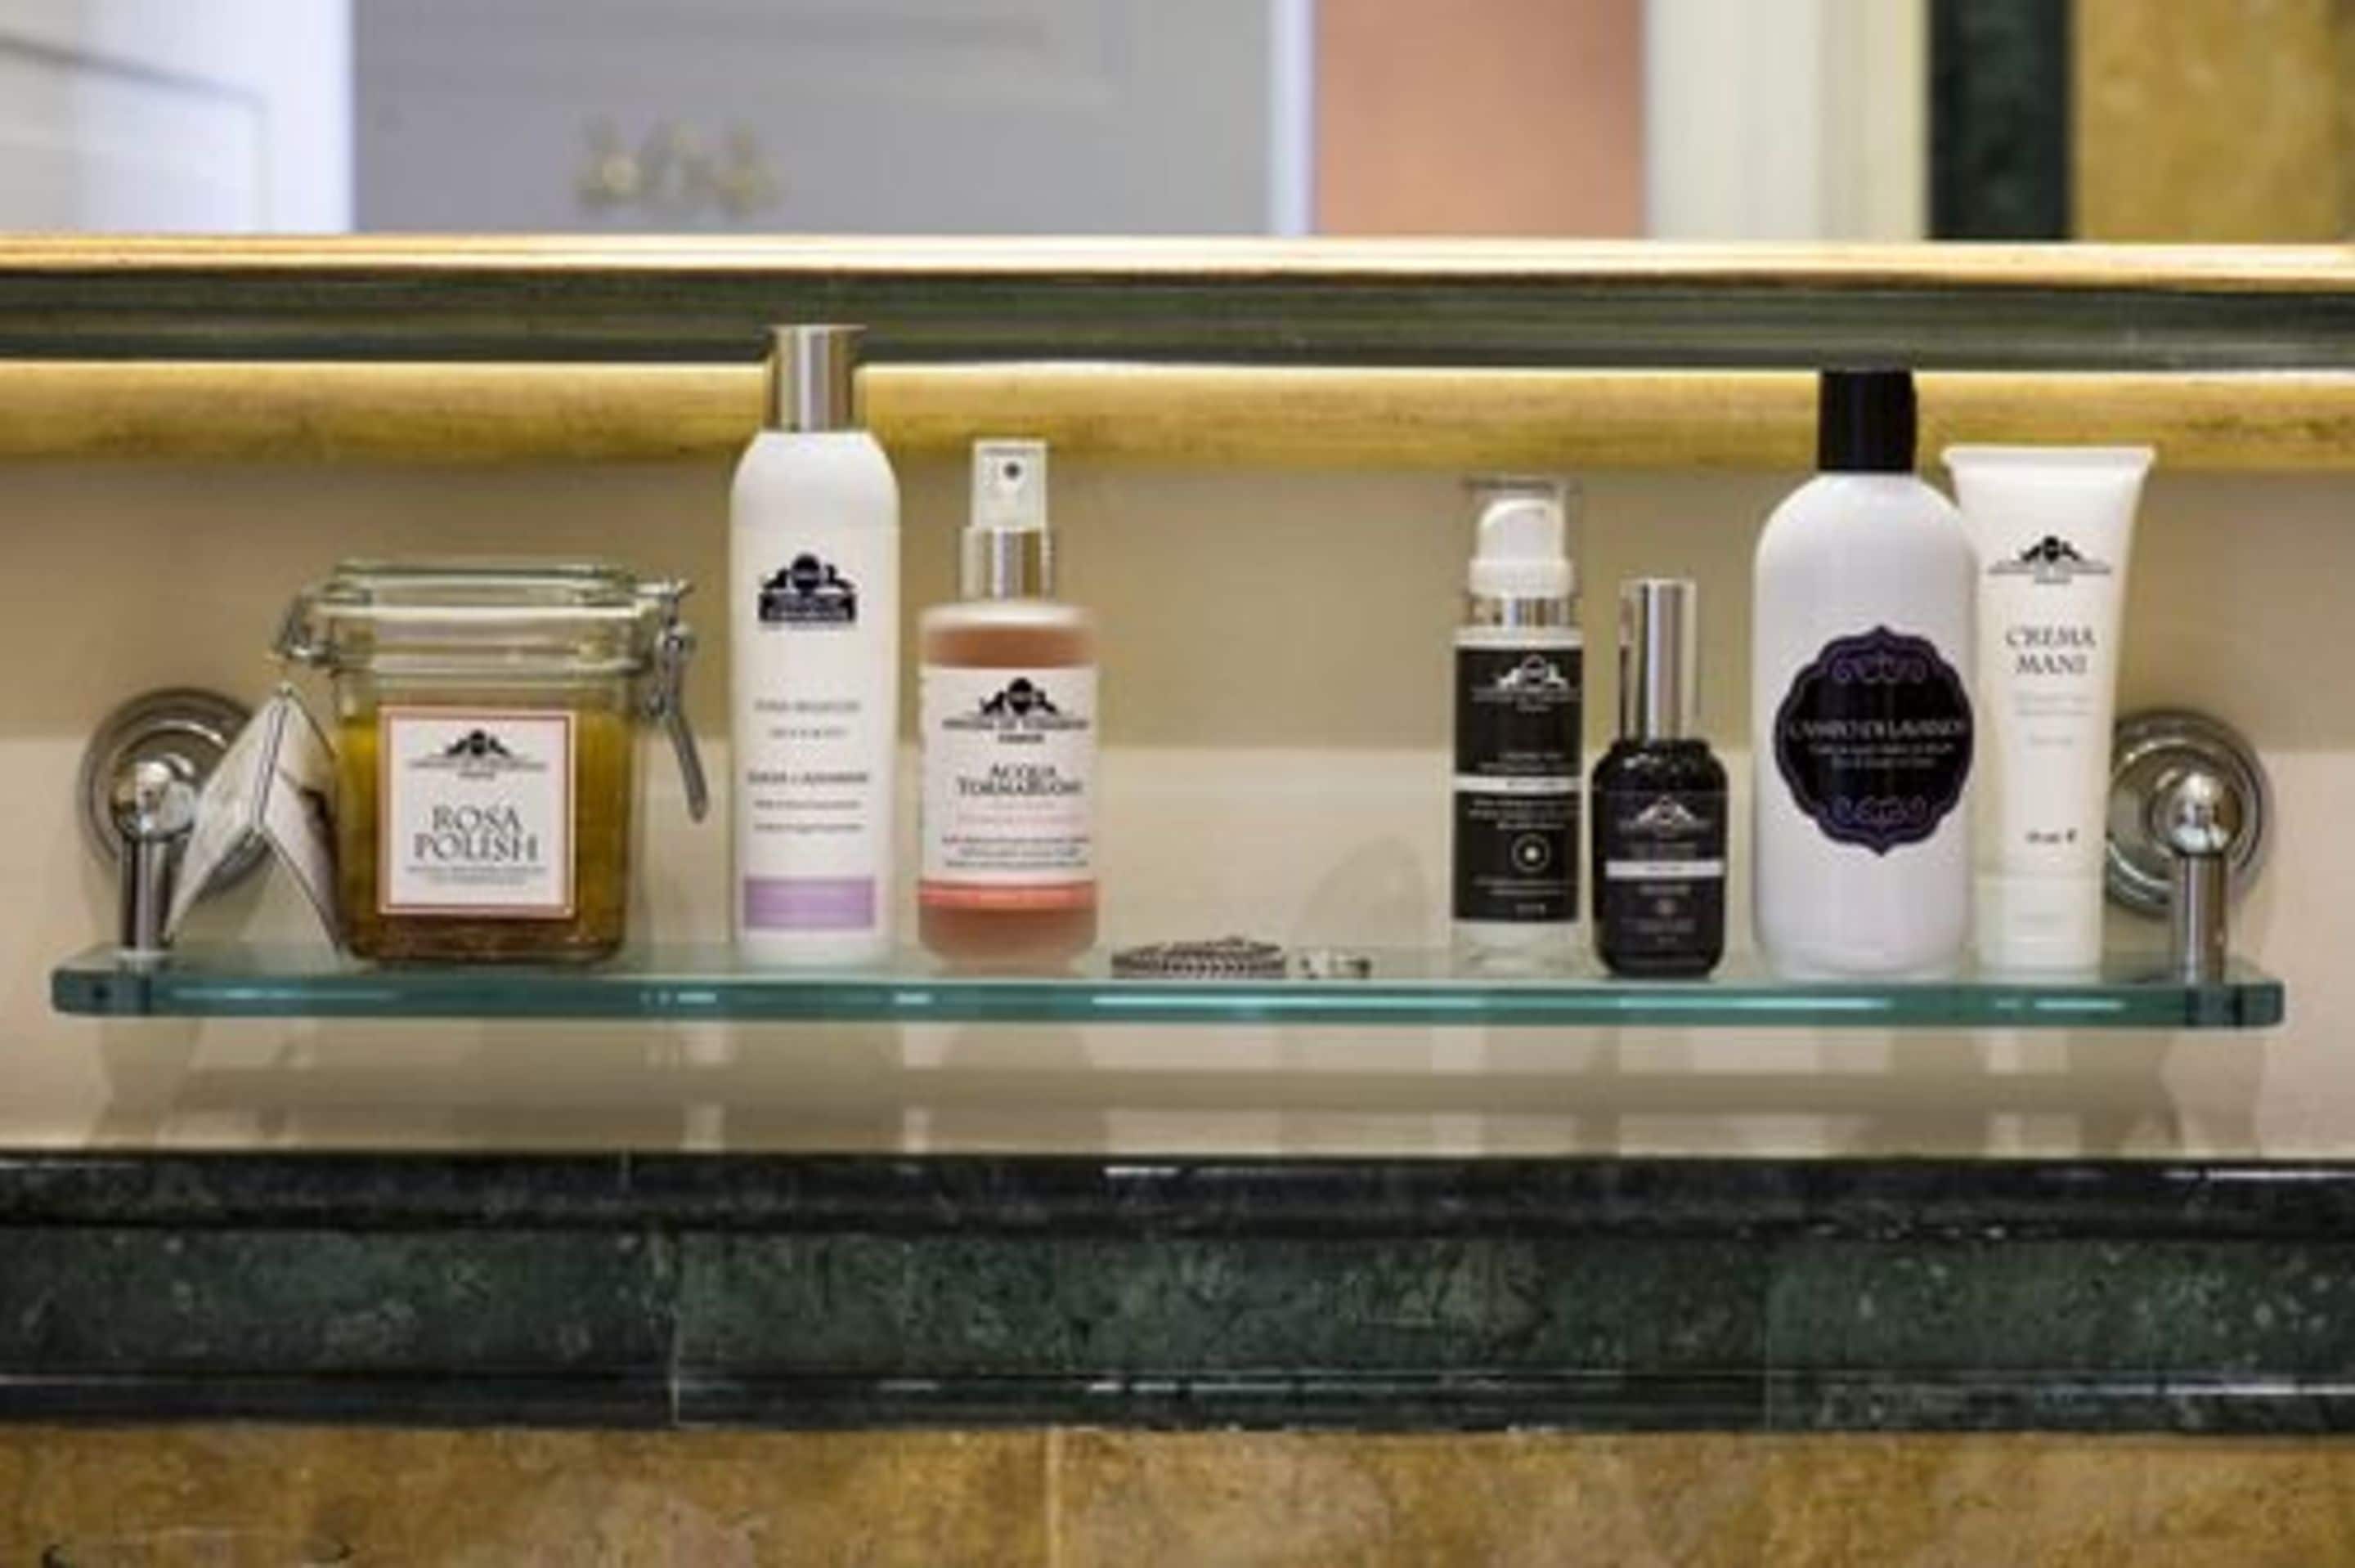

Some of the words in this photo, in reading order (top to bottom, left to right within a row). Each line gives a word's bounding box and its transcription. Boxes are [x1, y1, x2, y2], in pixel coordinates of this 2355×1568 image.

[2006, 628, 2096, 648] CREMA
[2016, 656, 2087, 675] MANI
[414, 833, 537, 862] POLISH
